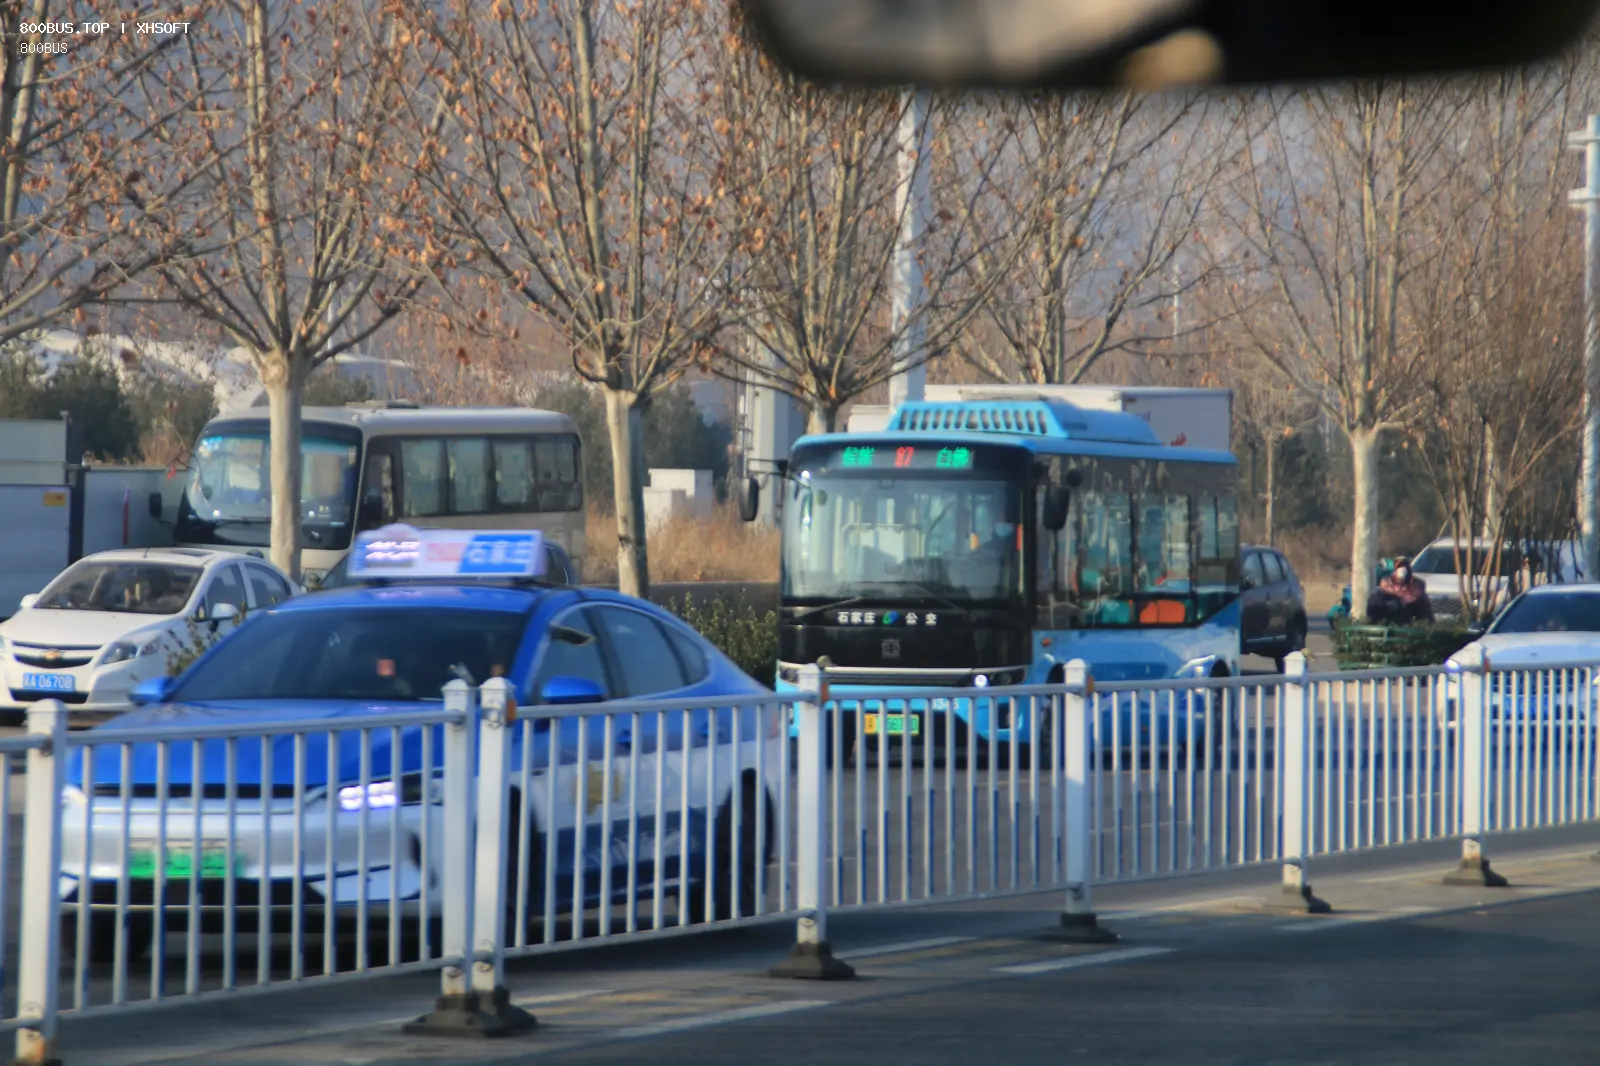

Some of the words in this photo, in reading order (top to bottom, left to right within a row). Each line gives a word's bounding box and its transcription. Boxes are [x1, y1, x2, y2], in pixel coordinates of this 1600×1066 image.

[837, 611, 876, 625] 石家庄
[905, 611, 938, 626] 公交
